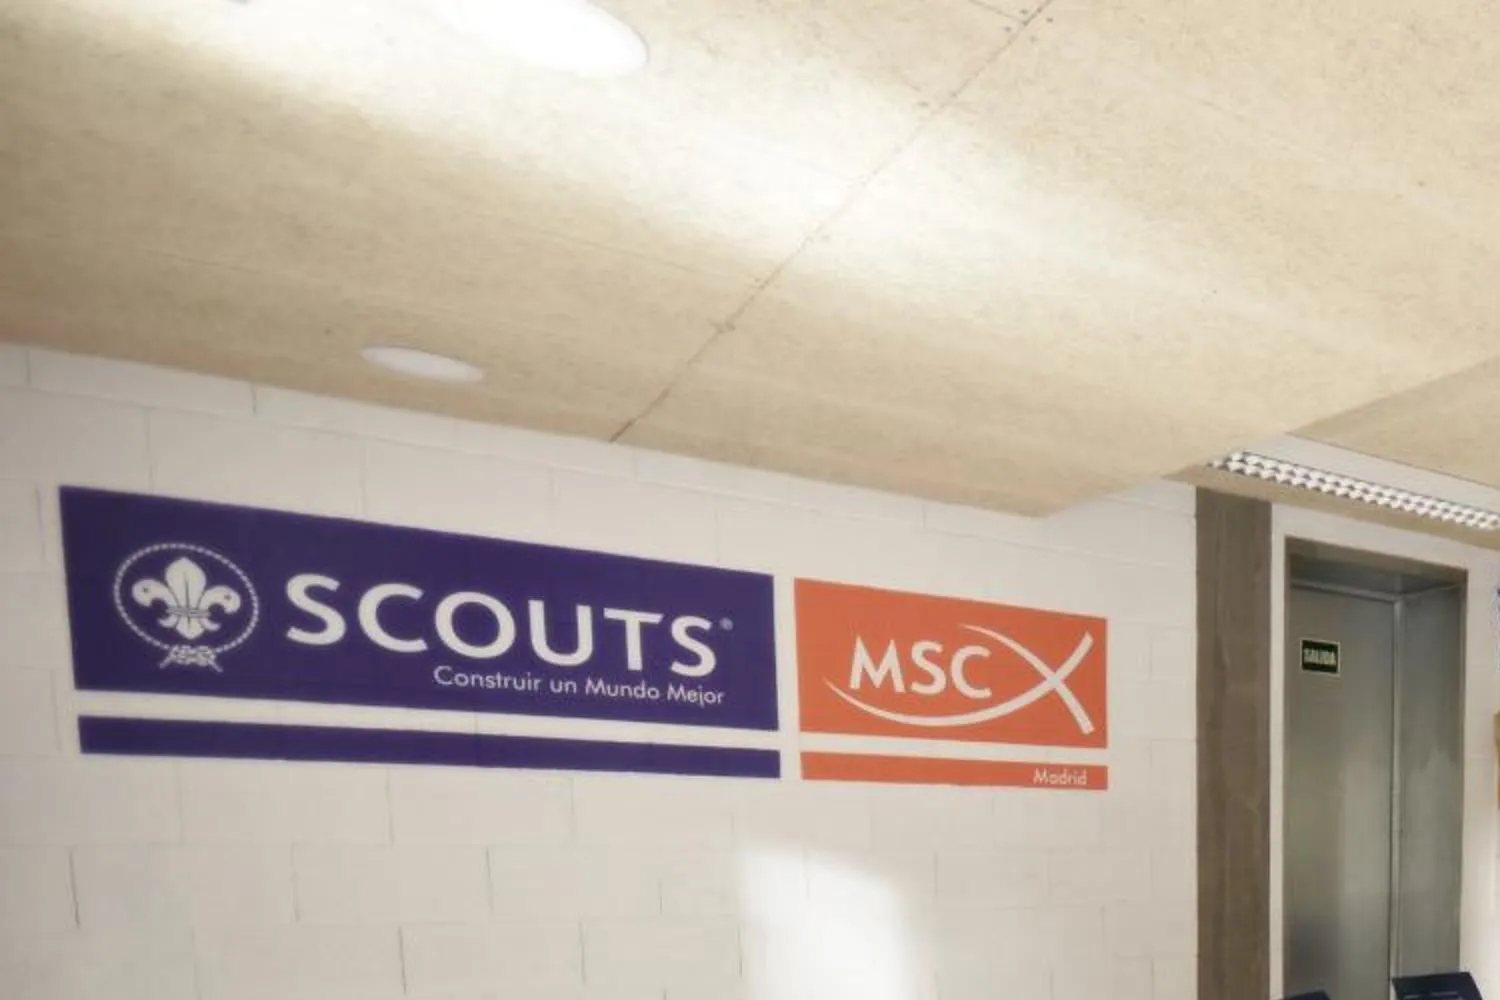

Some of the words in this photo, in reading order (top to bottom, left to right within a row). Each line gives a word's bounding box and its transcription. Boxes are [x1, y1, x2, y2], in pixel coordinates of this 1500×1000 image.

[286, 572, 718, 677] SCOUTS
[433, 664, 542, 692] Construir
[549, 674, 577, 694] un
[585, 679, 661, 700] Mundo
[667, 684, 726, 709] Mejor
[849, 635, 992, 700] MSC
[1033, 767, 1087, 785] Madrid
